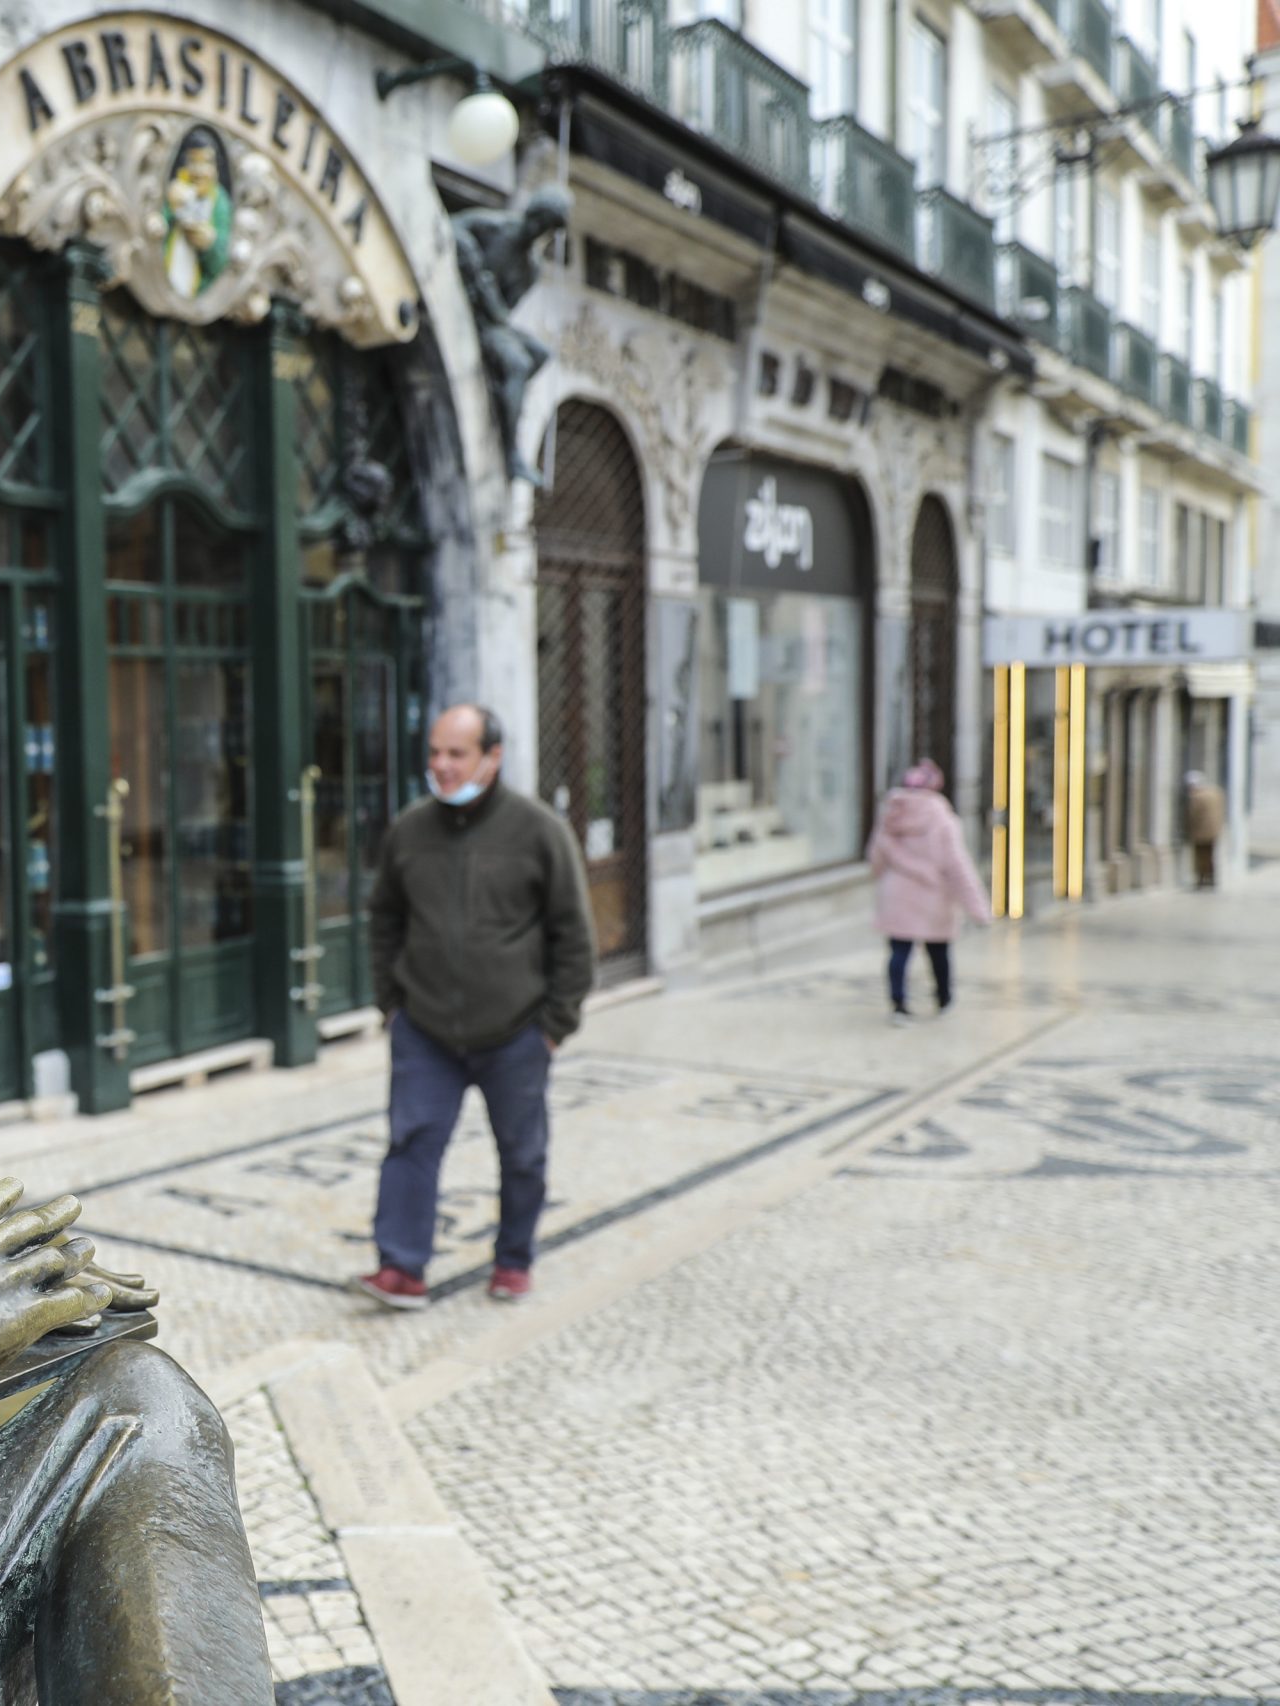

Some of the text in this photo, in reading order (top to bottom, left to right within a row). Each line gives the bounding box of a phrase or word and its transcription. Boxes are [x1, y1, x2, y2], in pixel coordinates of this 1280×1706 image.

[19, 30, 365, 244] A BRASILEIRA
[1043, 617, 1200, 655] HOTEL
